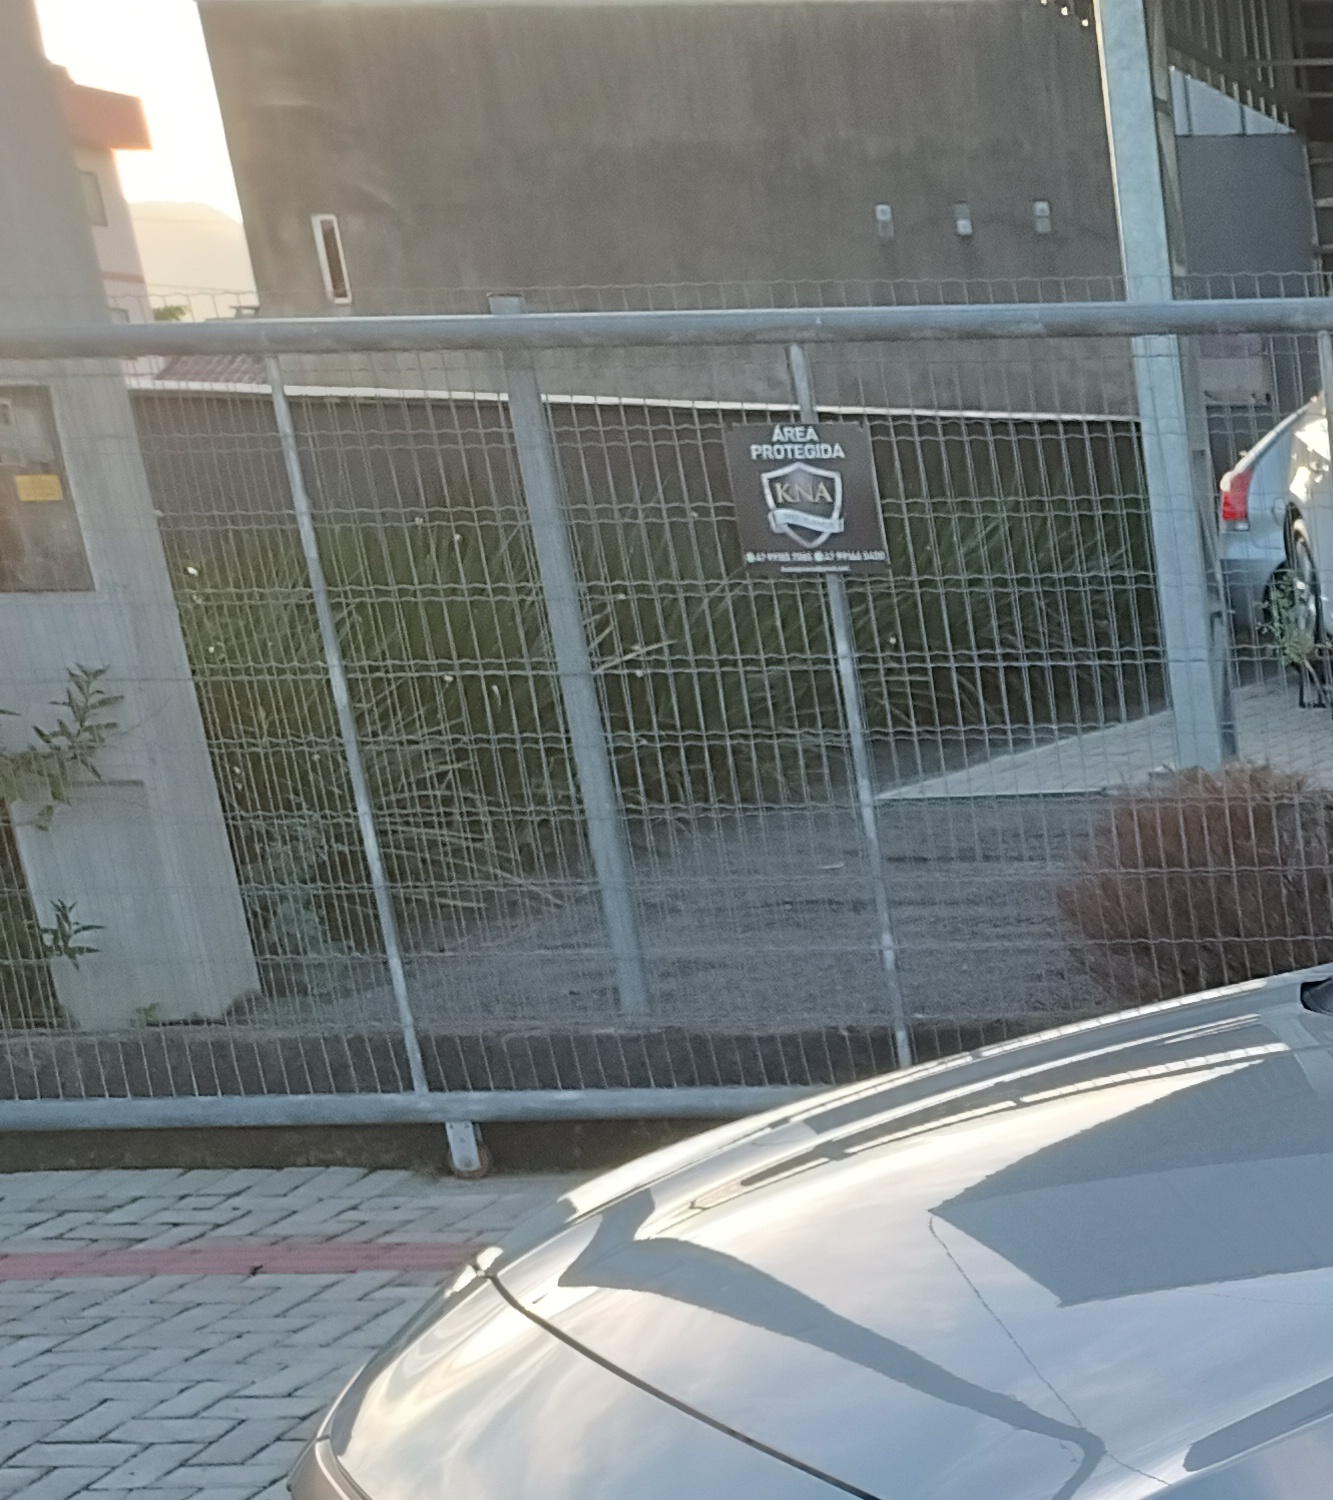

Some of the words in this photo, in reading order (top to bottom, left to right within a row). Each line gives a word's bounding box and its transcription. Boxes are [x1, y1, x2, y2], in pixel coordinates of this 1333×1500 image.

[771, 424, 818, 442] ÁREA
[750, 443, 846, 459] PROTEGIDA
[774, 481, 833, 503] KNA
